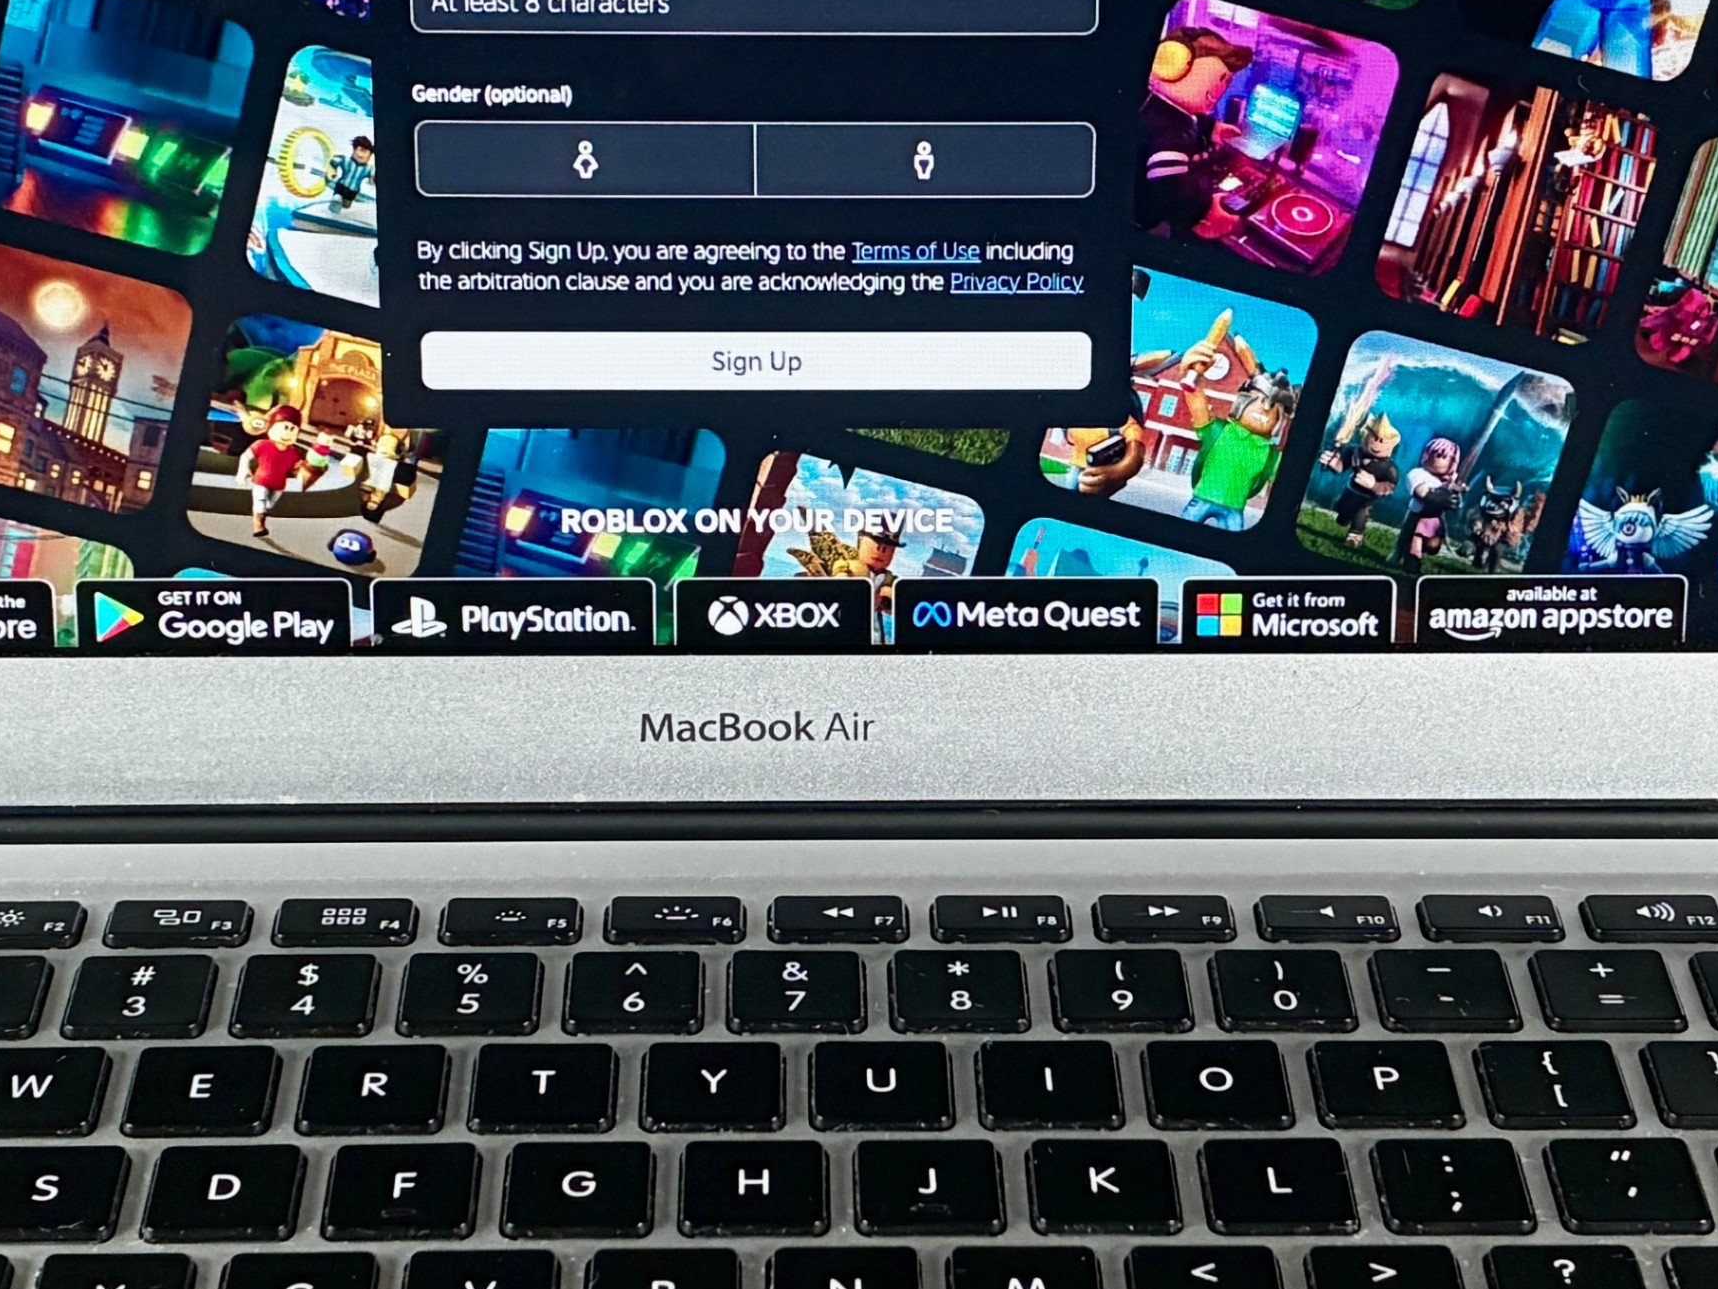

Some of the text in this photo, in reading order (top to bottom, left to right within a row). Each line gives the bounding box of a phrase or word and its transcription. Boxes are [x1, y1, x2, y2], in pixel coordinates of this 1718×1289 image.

[411, 83, 573, 108] Gender (optional)
[417, 240, 444, 264] By
[448, 240, 523, 265] clicking
[528, 240, 572, 265] Sign
[612, 244, 651, 265] you
[655, 244, 689, 261] are
[693, 241, 781, 266] agreeing
[785, 243, 807, 261] to
[811, 241, 846, 261] the
[853, 241, 910, 261] Terms
[916, 241, 937, 261] of
[943, 242, 981, 261] Use
[985, 241, 1074, 265] including
[418, 271, 1084, 297] the arbitration clause and you are acknowledging the Privacy Policy
[712, 350, 803, 377] Sign Up
[561, 508, 955, 534] ROBLOX ON YOUR DEVICE
[157, 590, 242, 606] GET IT ON
[1252, 591, 1346, 608] Get it from
[1506, 585, 1598, 602] available at
[753, 601, 840, 628] XBOX
[956, 600, 1141, 632] Meta Quest
[1252, 610, 1379, 637] Microsoft
[1429, 603, 1674, 638] amazon appstore
[158, 610, 335, 646] Google Play
[640, 710, 875, 742] MacBook Air
[43, 921, 66, 932] F2
[210, 920, 233, 931] F3
[379, 919, 400, 930] F4
[547, 918, 567, 929] F5
[712, 916, 733, 927] F6
[874, 916, 895, 926] F7
[1036, 915, 1058, 926] F8
[1201, 915, 1222, 926] F9
[1356, 915, 1386, 925] F10
[1525, 915, 1551, 925] F11
[1686, 915, 1717, 926] F12
[122, 995, 146, 1017] 3
[290, 994, 315, 1016] 4
[622, 991, 645, 1012] 6
[784, 990, 807, 1011] 7
[950, 990, 973, 1011] 8
[1111, 989, 1134, 1011] 9
[11, 1074, 54, 1099] W
[189, 1073, 215, 1099] E
[361, 1072, 388, 1097] R
[531, 1070, 557, 1095] T
[700, 1069, 728, 1094] Y
[866, 1067, 897, 1093] U
[1373, 1066, 1400, 1091] P
[207, 1173, 242, 1201] D
[392, 1171, 418, 1199] F
[561, 1170, 597, 1198] G
[738, 1168, 770, 1196] H
[918, 1167, 937, 1195] J
[1088, 1166, 1120, 1194] K
[1266, 1166, 1293, 1194] L
